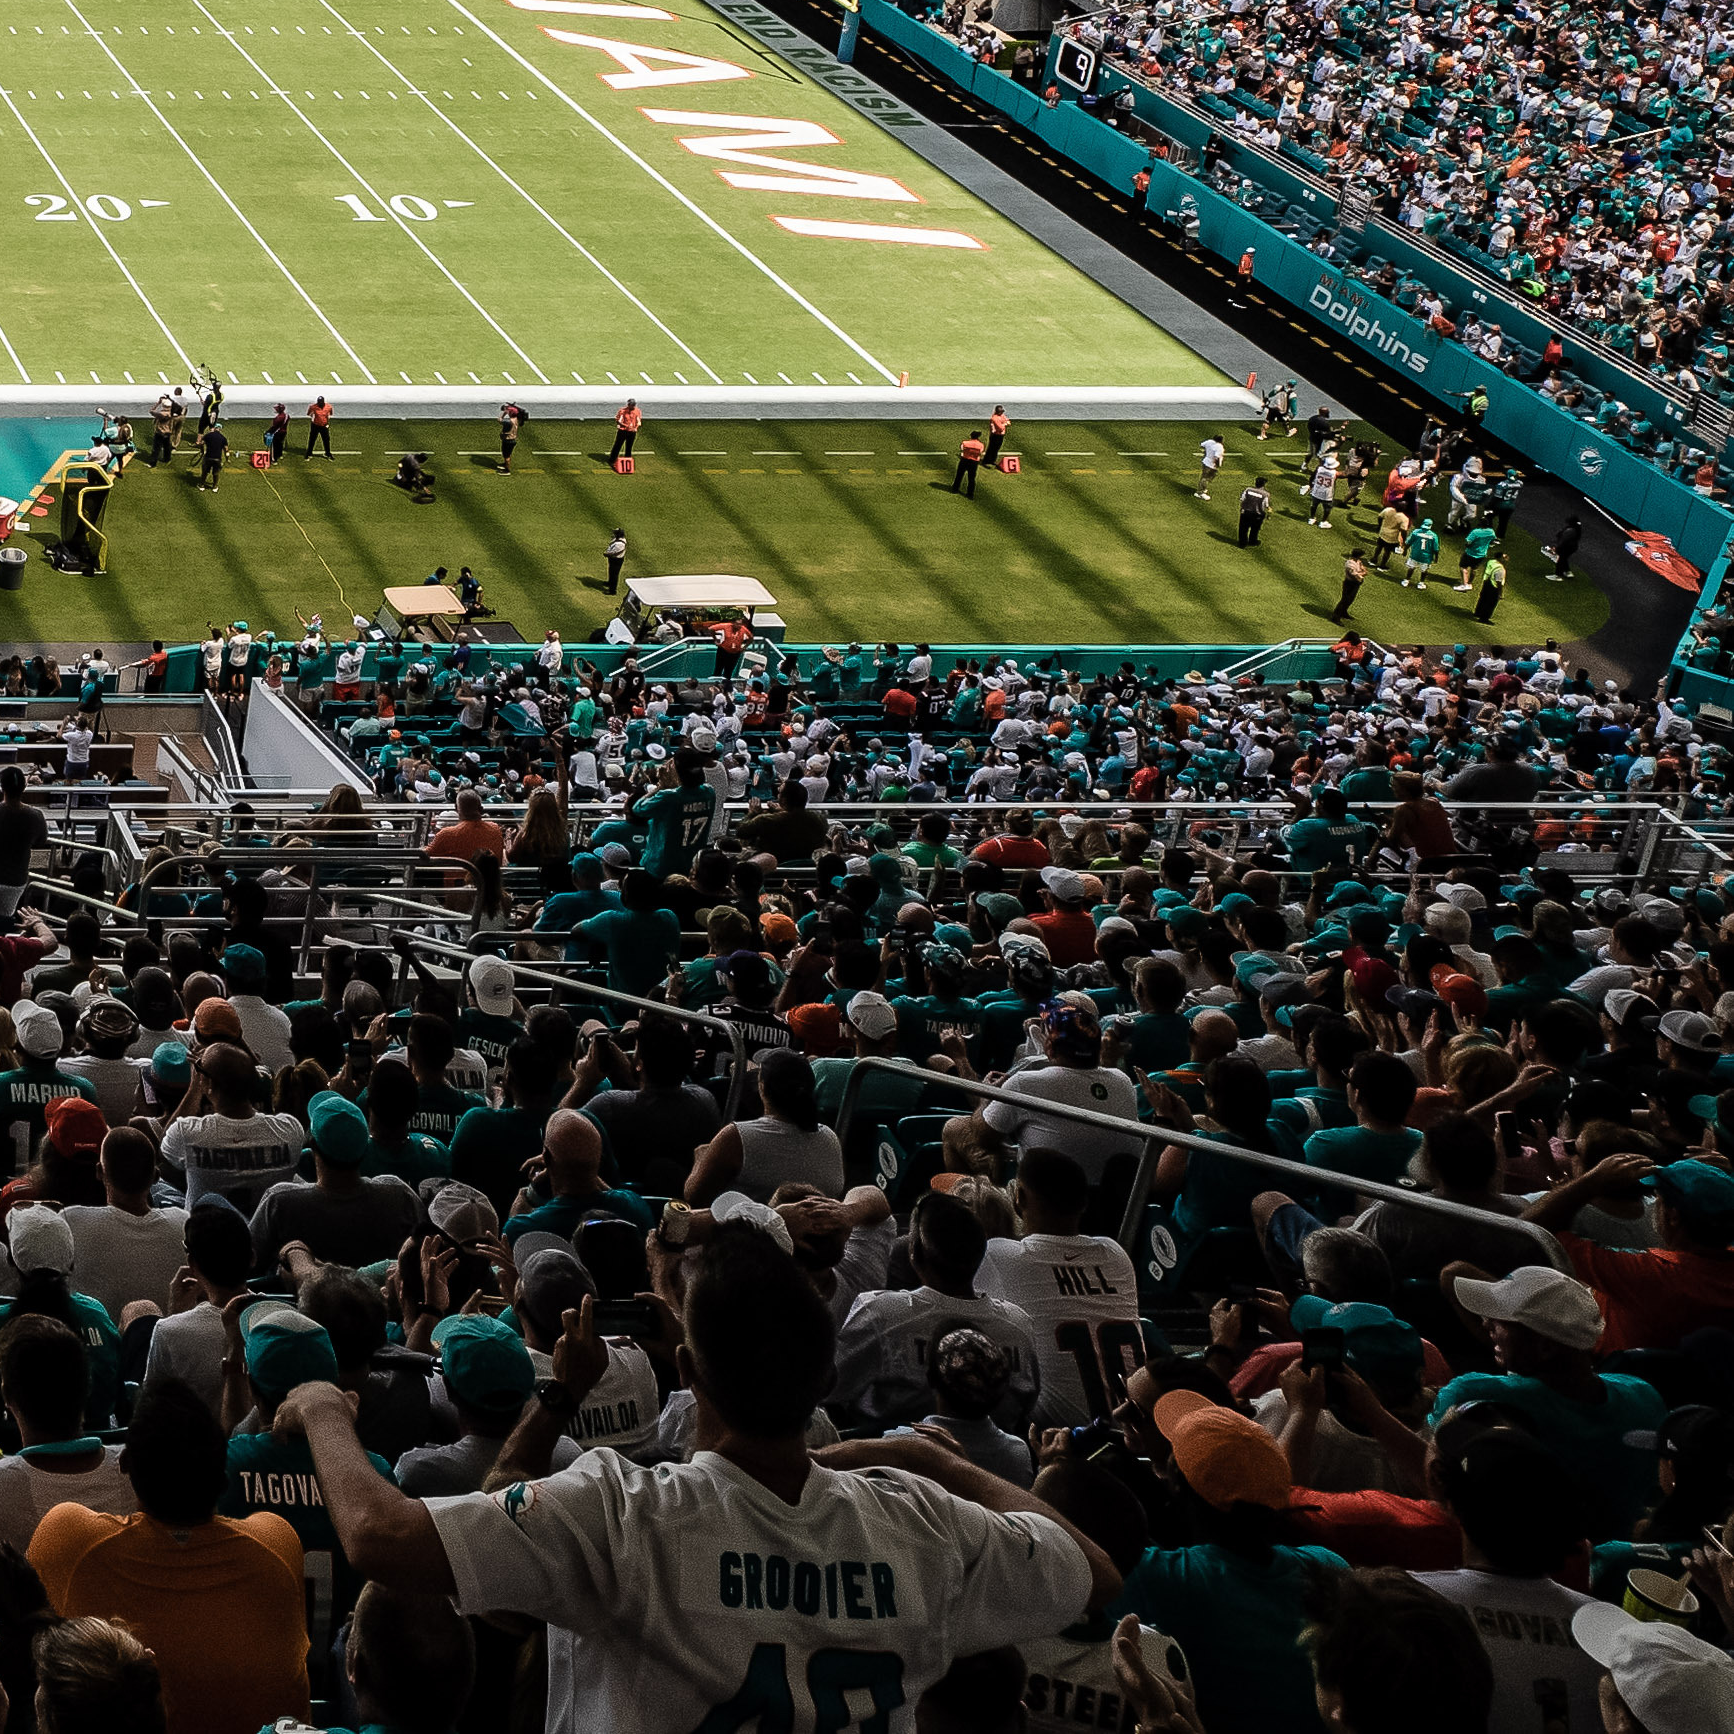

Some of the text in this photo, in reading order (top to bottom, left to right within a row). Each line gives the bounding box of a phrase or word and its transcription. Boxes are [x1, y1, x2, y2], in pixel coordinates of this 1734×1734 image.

[722, 2, 929, 127] END RACISM
[23, 193, 132, 221] 20
[333, 193, 439, 221] 10
[1319, 272, 1372, 313] MIAMI
[1308, 283, 1430, 374] Dolphins
[10, 1082, 81, 1104] MARINO
[1052, 1266, 1118, 1296] HILL
